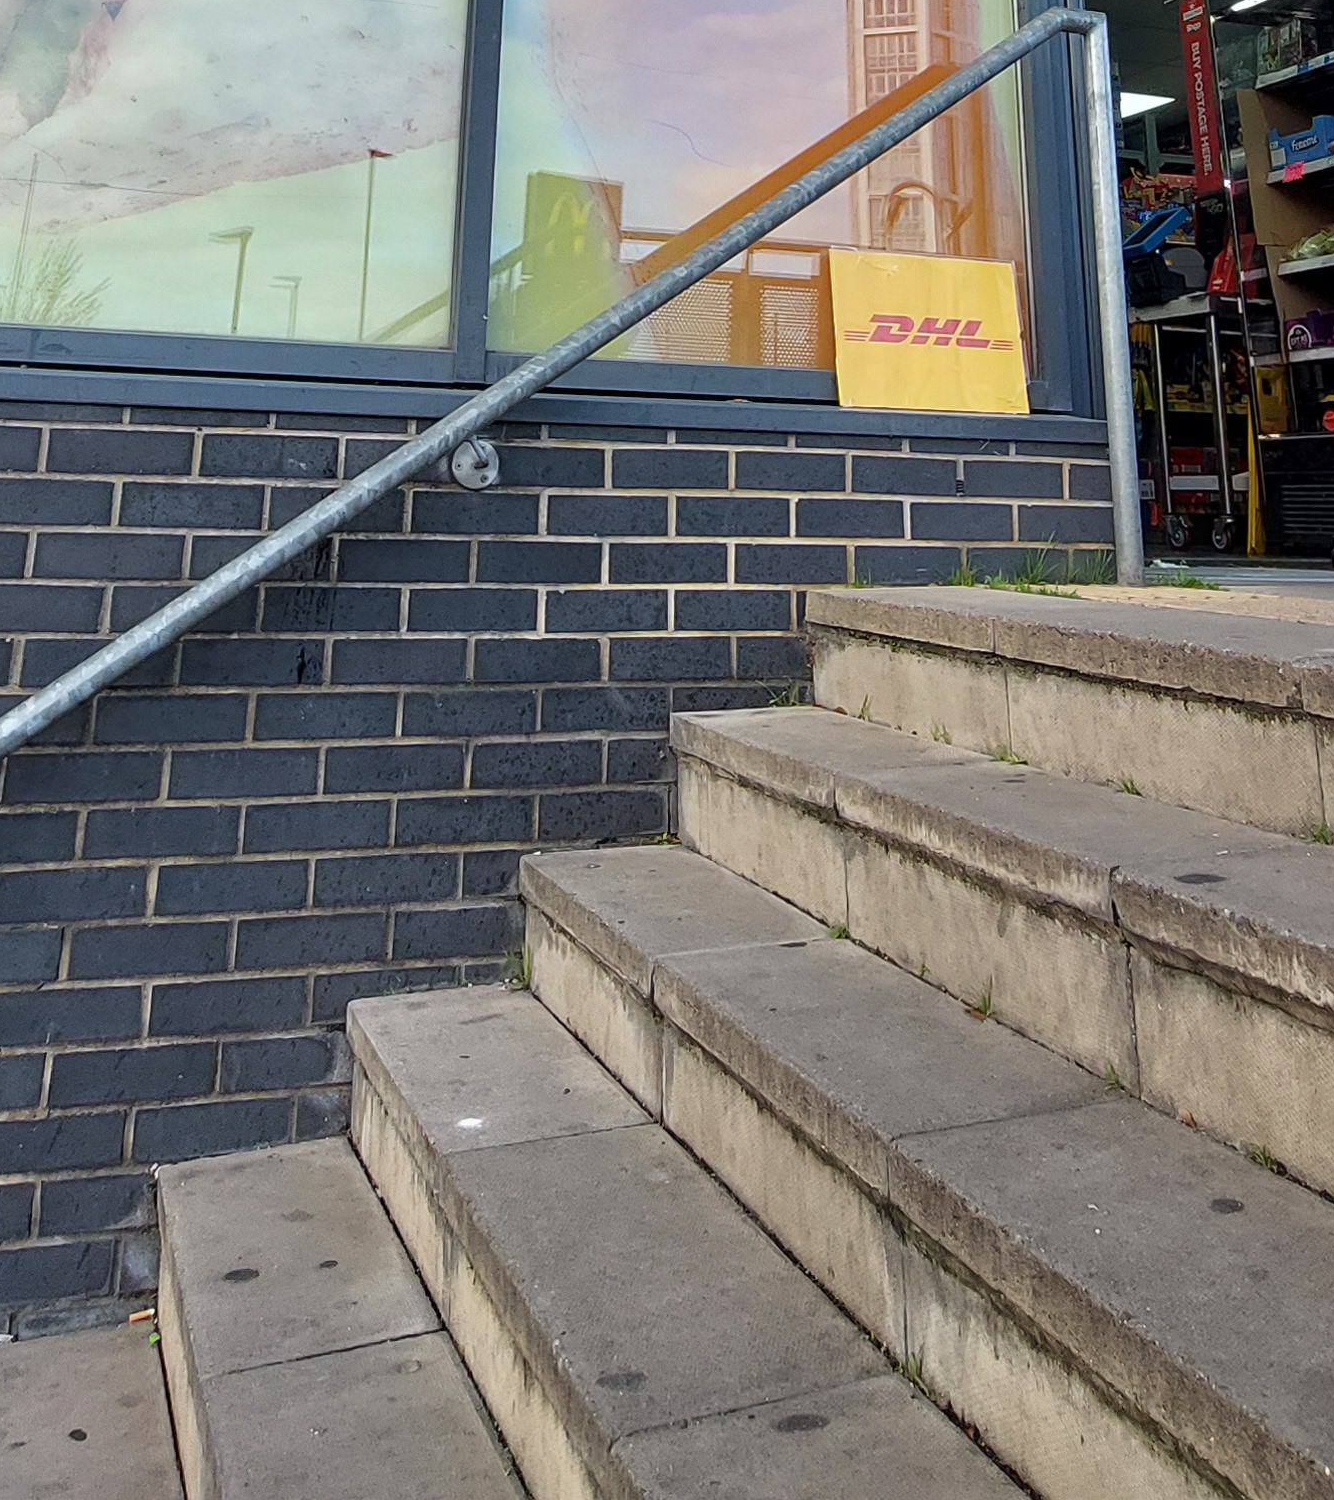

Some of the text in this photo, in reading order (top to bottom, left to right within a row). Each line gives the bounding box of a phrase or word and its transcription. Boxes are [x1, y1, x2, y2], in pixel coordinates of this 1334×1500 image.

[1190, 41, 1202, 70] BUY
[1193, 70, 1209, 135] POSTAGE
[1199, 136, 1214, 176] HERE.
[868, 314, 992, 350] DHL
